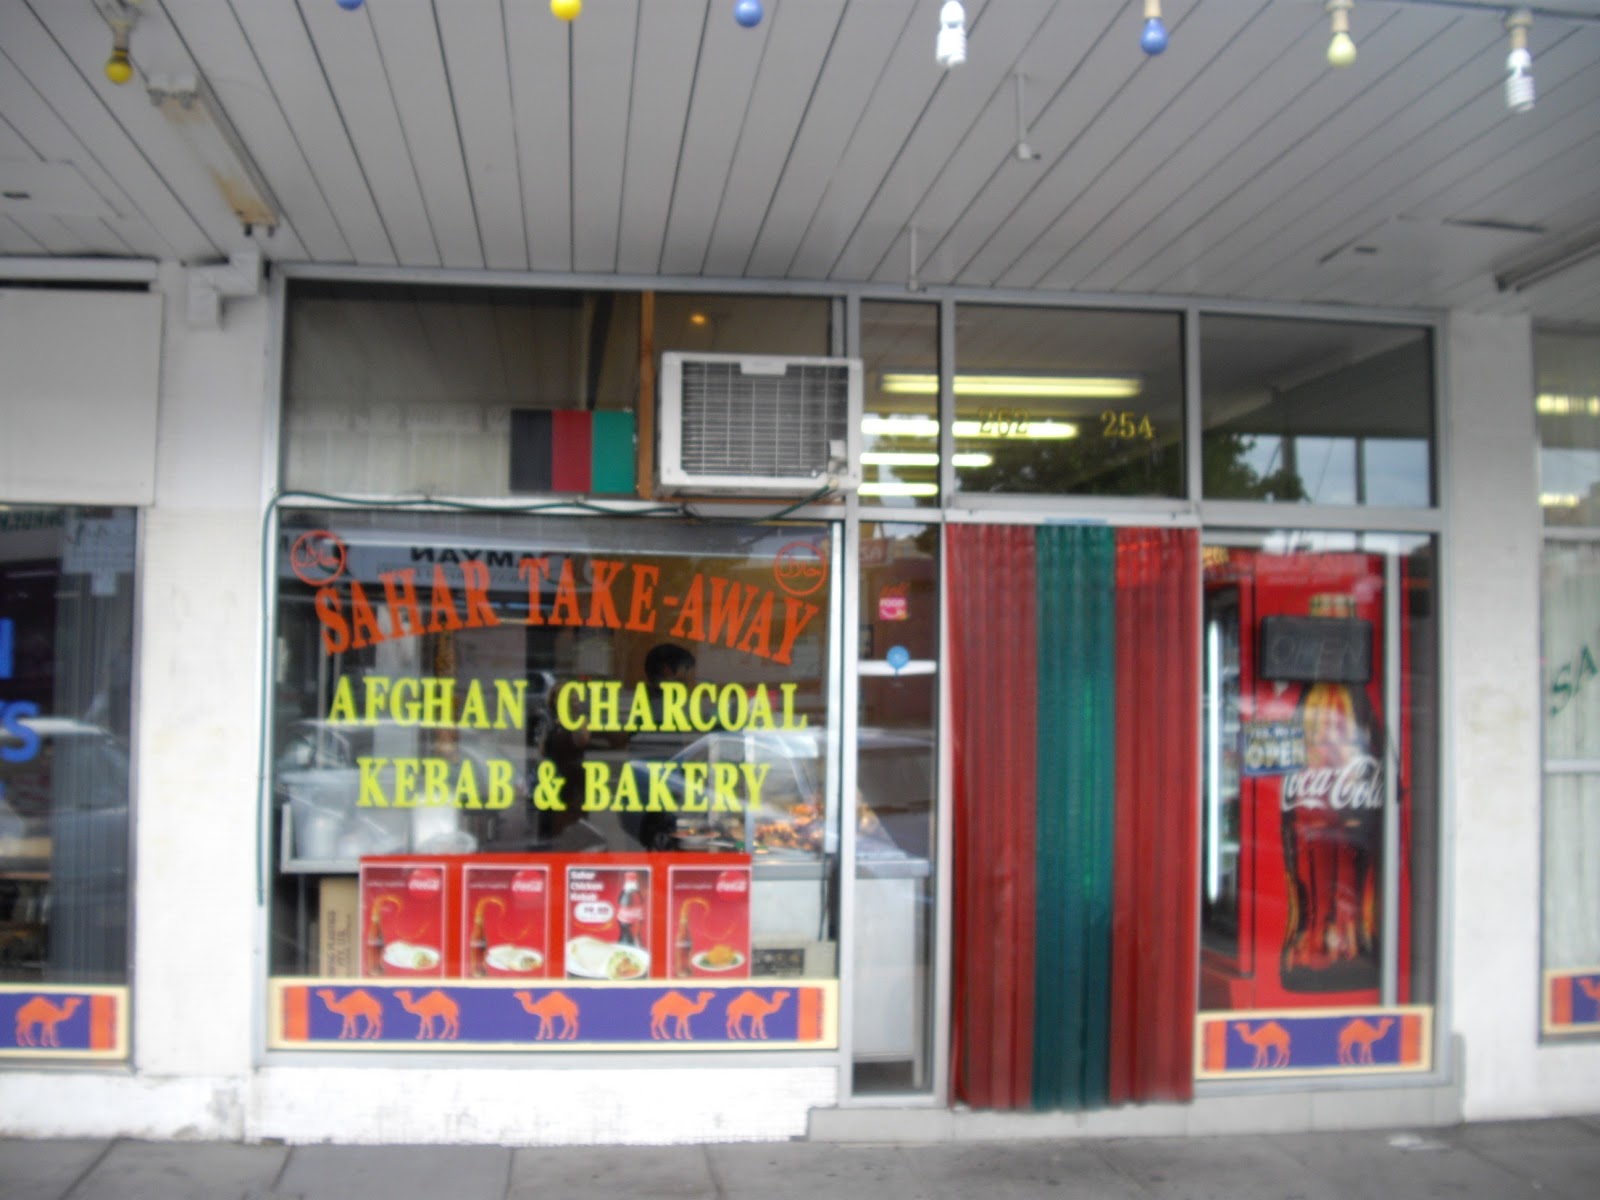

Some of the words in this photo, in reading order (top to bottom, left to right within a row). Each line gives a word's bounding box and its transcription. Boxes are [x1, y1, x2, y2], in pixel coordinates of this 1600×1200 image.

[1101, 409, 1154, 440] 254
[315, 561, 499, 655] SAHAR
[519, 558, 819, 666] TAKE-AWAY
[328, 676, 528, 730] AFGHAN
[556, 681, 808, 732] CHARCOAL
[356, 757, 516, 810] KEBAB
[533, 760, 566, 811] &
[582, 761, 770, 812] BAKERY
